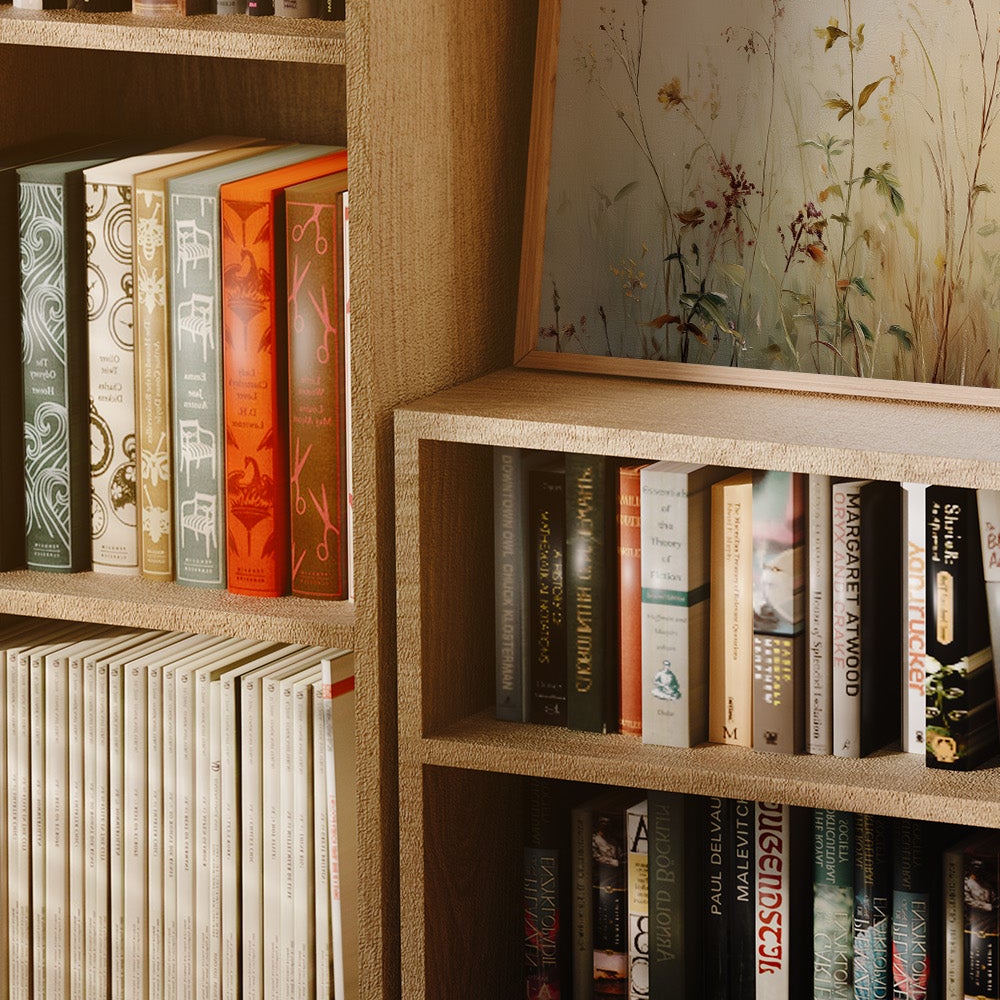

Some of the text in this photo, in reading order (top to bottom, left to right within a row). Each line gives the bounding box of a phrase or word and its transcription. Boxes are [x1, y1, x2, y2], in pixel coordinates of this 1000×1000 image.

[658, 521, 674, 530] the
[502, 530, 514, 556] OWL
[650, 538, 682, 550] Theory
[662, 556, 672, 564] of
[650, 572, 682, 582] Fiction
[834, 492, 846, 669] ORYX AND CRAKE
[846, 493, 860, 697] MARGARET ATWOOD
[502, 610, 514, 690] KLOSTERMAN
[710, 875, 722, 916] PAUL
